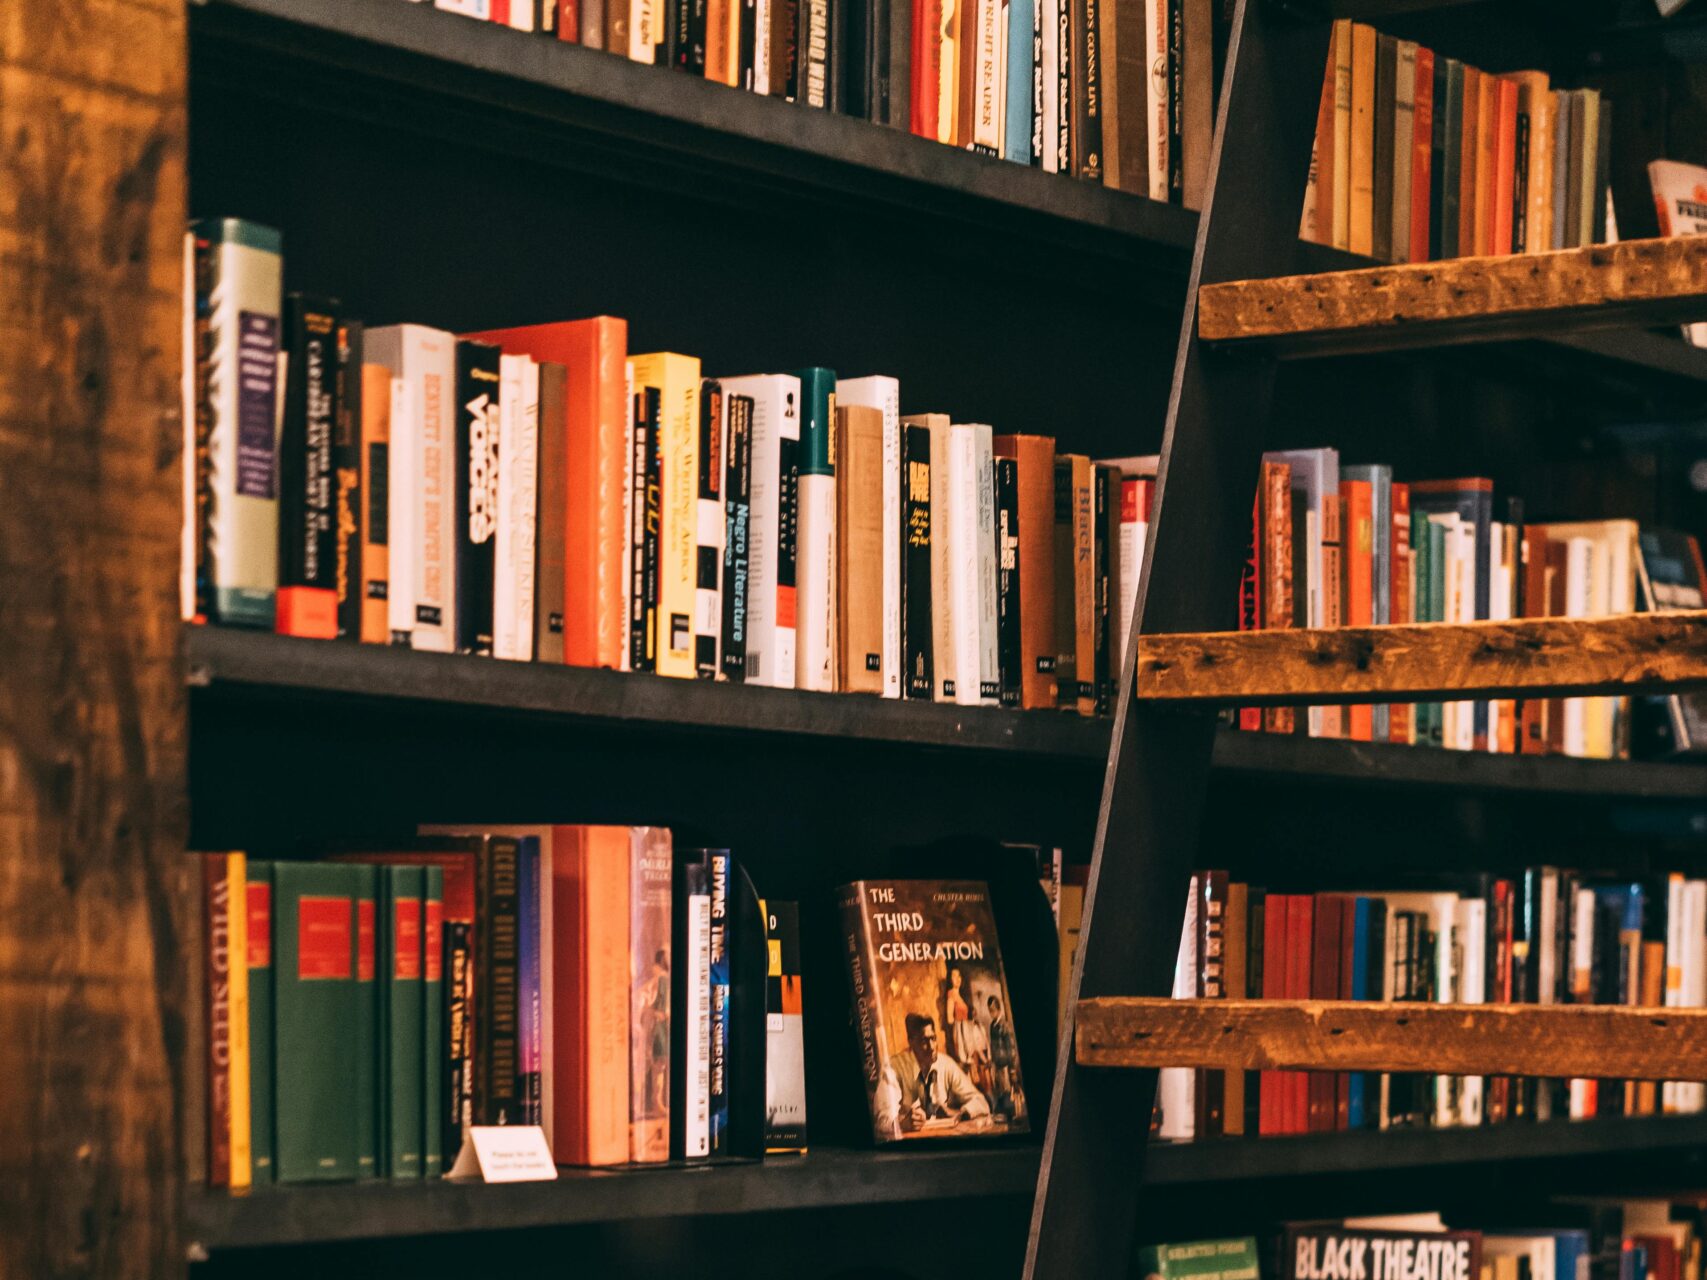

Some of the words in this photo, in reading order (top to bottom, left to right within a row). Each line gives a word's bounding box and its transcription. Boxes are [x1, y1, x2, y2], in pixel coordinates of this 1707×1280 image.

[639, 10, 653, 47] Light
[809, 0, 827, 60] ICHARD
[1059, 14, 1069, 76] Outsider
[1087, 32, 1096, 83] GONNA
[807, 62, 825, 109] WRIG
[983, 60, 994, 126] READER
[1034, 67, 1043, 114] Richard
[1060, 78, 1069, 126] Richard
[1088, 86, 1097, 117] LIVE
[1032, 116, 1042, 157] Wright
[1058, 128, 1069, 170] Wright
[307, 340, 321, 447] CARIBBEAN
[425, 373, 442, 442] BENNETT
[683, 387, 693, 446] WOMEN
[736, 399, 744, 434] DARK
[307, 451, 320, 505] SHORT
[466, 393, 489, 545] VOICES
[671, 445, 681, 502] Southern
[681, 453, 692, 518] WRITING
[780, 473, 788, 508] THE
[726, 501, 735, 513] in
[789, 465, 798, 536] CENTERS
[1078, 486, 1092, 563] Black
[305, 511, 319, 580] STORIES
[425, 501, 442, 561] BUMPER
[669, 507, 680, 552] Region
[680, 524, 691, 583] AFRICA
[724, 515, 735, 567] America
[732, 503, 750, 554] Negro
[780, 513, 788, 552] SELF
[789, 544, 796, 564] OF
[425, 566, 442, 601] CROP
[732, 558, 748, 642] Literature
[942, 607, 951, 648] Africa
[710, 856, 726, 918] BUYING
[869, 887, 896, 903] THE
[212, 879, 230, 974] WILD
[710, 924, 724, 965] TIME
[769, 914, 777, 930] D
[872, 912, 924, 932] THIRD
[699, 944, 709, 986] WILLIAMS
[851, 956, 865, 996] THIRD
[879, 941, 984, 962] GENERATION
[211, 982, 229, 1066] SEED
[493, 965, 516, 1032] ANTHONY
[532, 999, 540, 1054] RAINBOW
[857, 998, 878, 1081] GENERATION
[1295, 1236, 1367, 1280] BLACK
